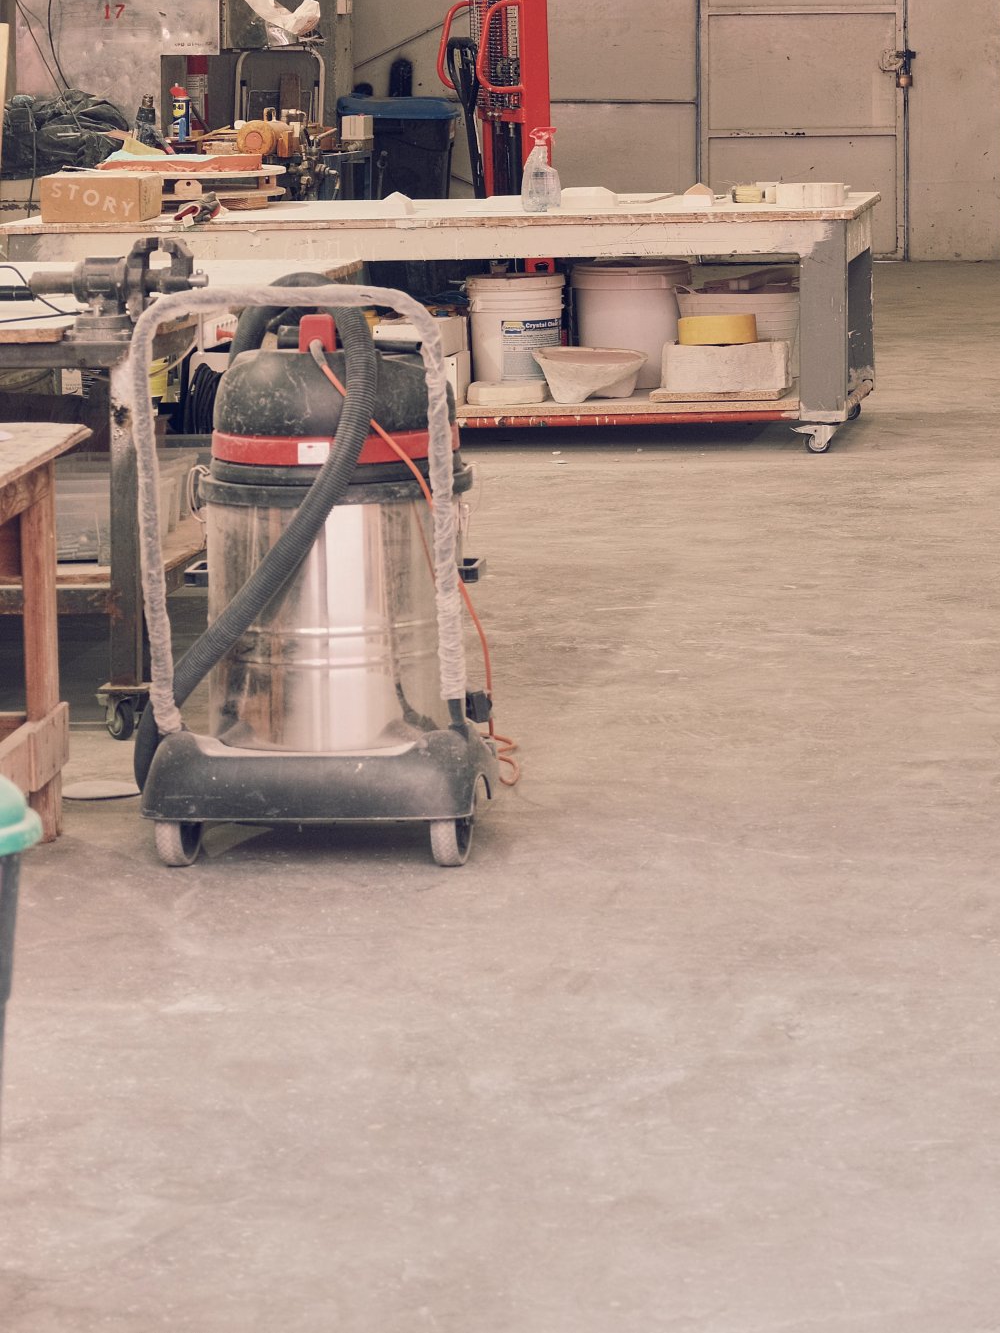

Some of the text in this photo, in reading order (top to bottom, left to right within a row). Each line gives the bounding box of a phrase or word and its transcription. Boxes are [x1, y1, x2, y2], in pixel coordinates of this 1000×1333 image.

[104, 3, 125, 20] 17
[50, 182, 135, 217] STORY
[525, 322, 547, 330] Crystal
